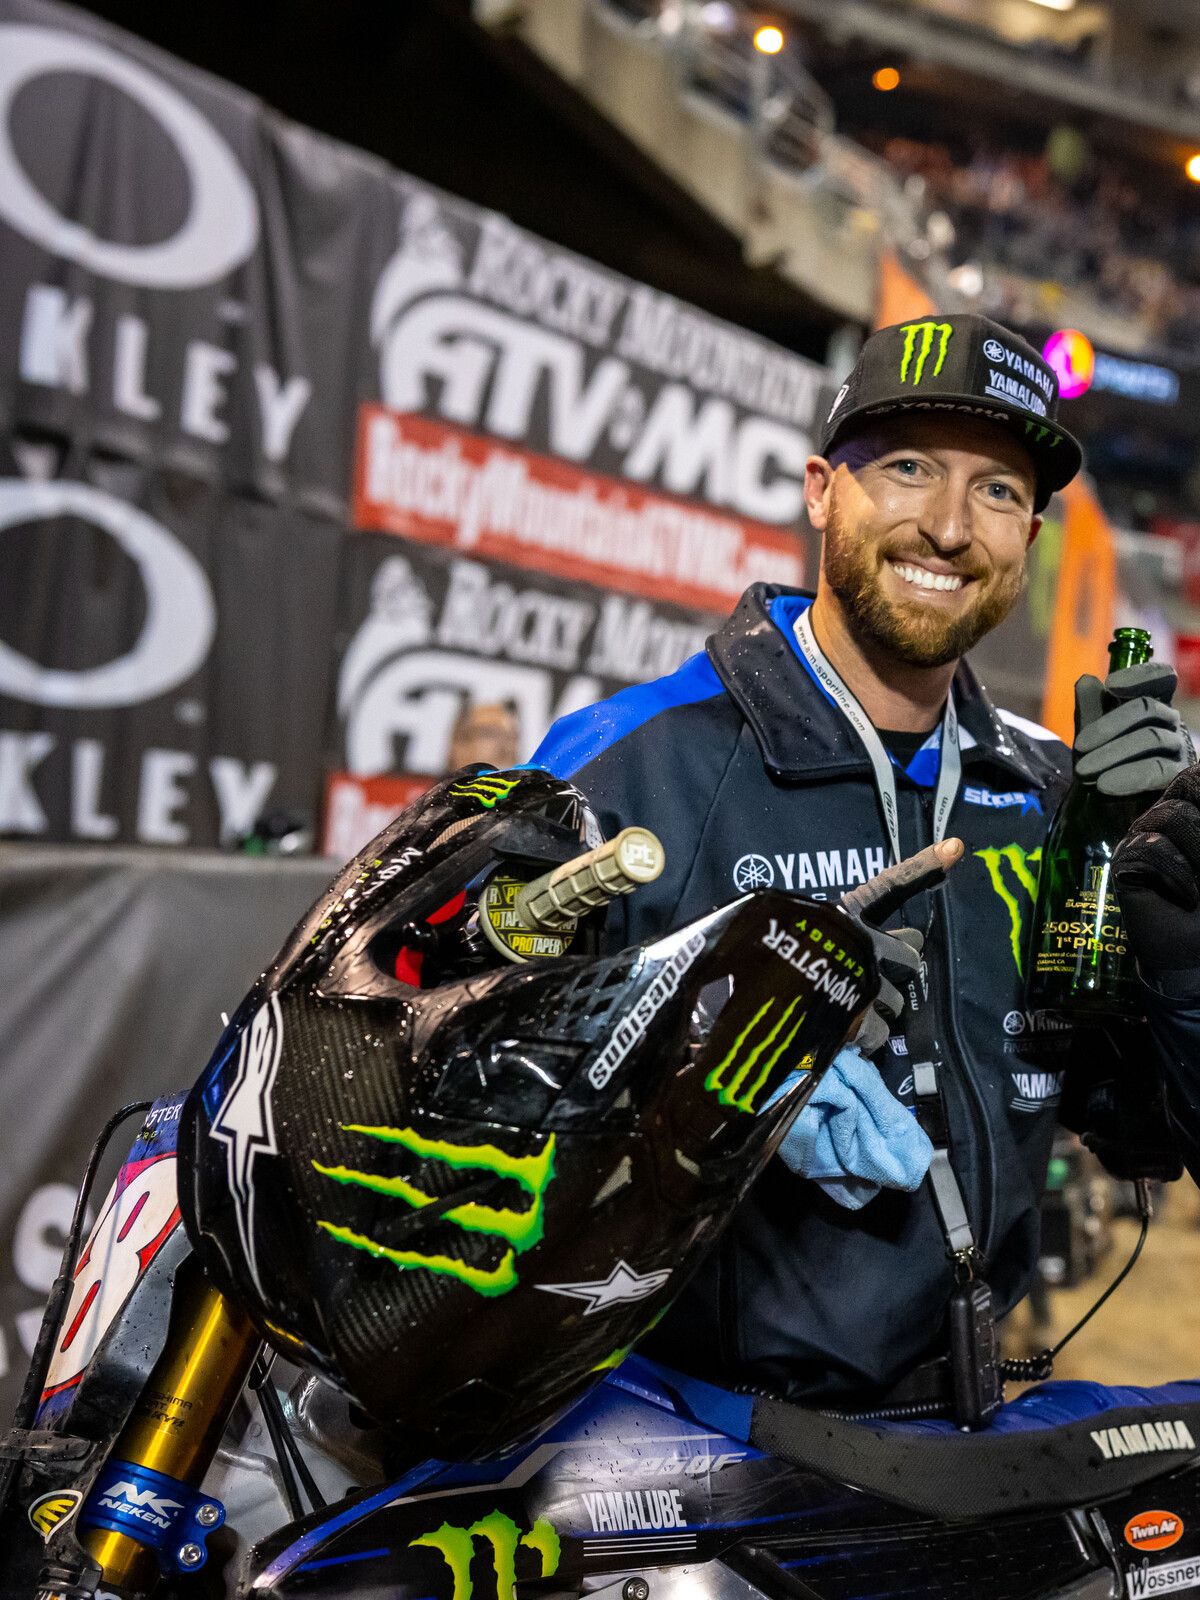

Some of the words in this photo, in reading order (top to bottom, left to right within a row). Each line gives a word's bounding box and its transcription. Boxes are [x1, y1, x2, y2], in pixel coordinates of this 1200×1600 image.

[775, 847, 893, 890] YAMAH
[511, 936, 561, 955] PROTAPER
[796, 919, 864, 977] ENERGY
[1056, 936, 1071, 949] 1st
[1073, 937, 1127, 955] Place
[1090, 1420, 1196, 1459] YAMAHA
[97, 1498, 171, 1529] NEKEN
[581, 1488, 688, 1532] YAMALUBE
[1130, 1522, 1161, 1540] Twin
[1159, 1518, 1178, 1534] Air
